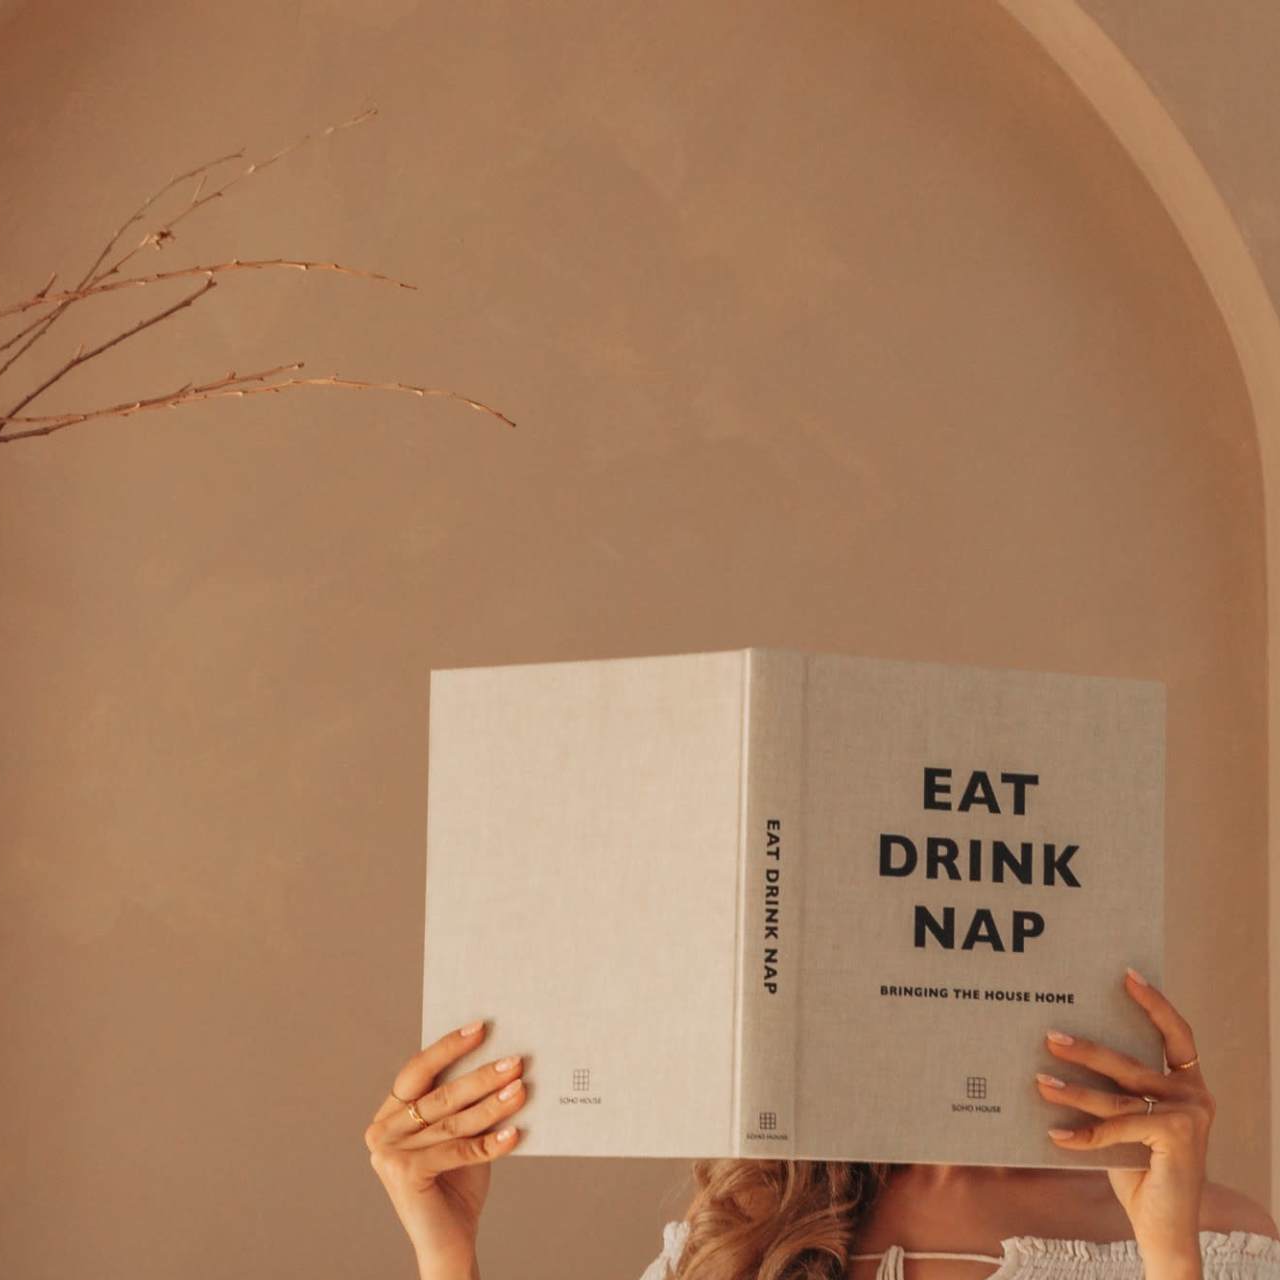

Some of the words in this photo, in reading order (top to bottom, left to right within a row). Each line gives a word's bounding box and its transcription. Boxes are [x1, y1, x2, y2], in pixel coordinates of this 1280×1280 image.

[923, 766, 1040, 816] EAT
[765, 818, 781, 861] EAT
[879, 833, 1082, 888] DRINK
[764, 868, 780, 940] DRINK
[913, 904, 1046, 953] NAP
[763, 947, 779, 995] NAP
[879, 984, 949, 999] BRINGING
[952, 987, 980, 1001] THE
[984, 989, 1031, 1003] HOUSE
[1034, 991, 1075, 1005] HOME
